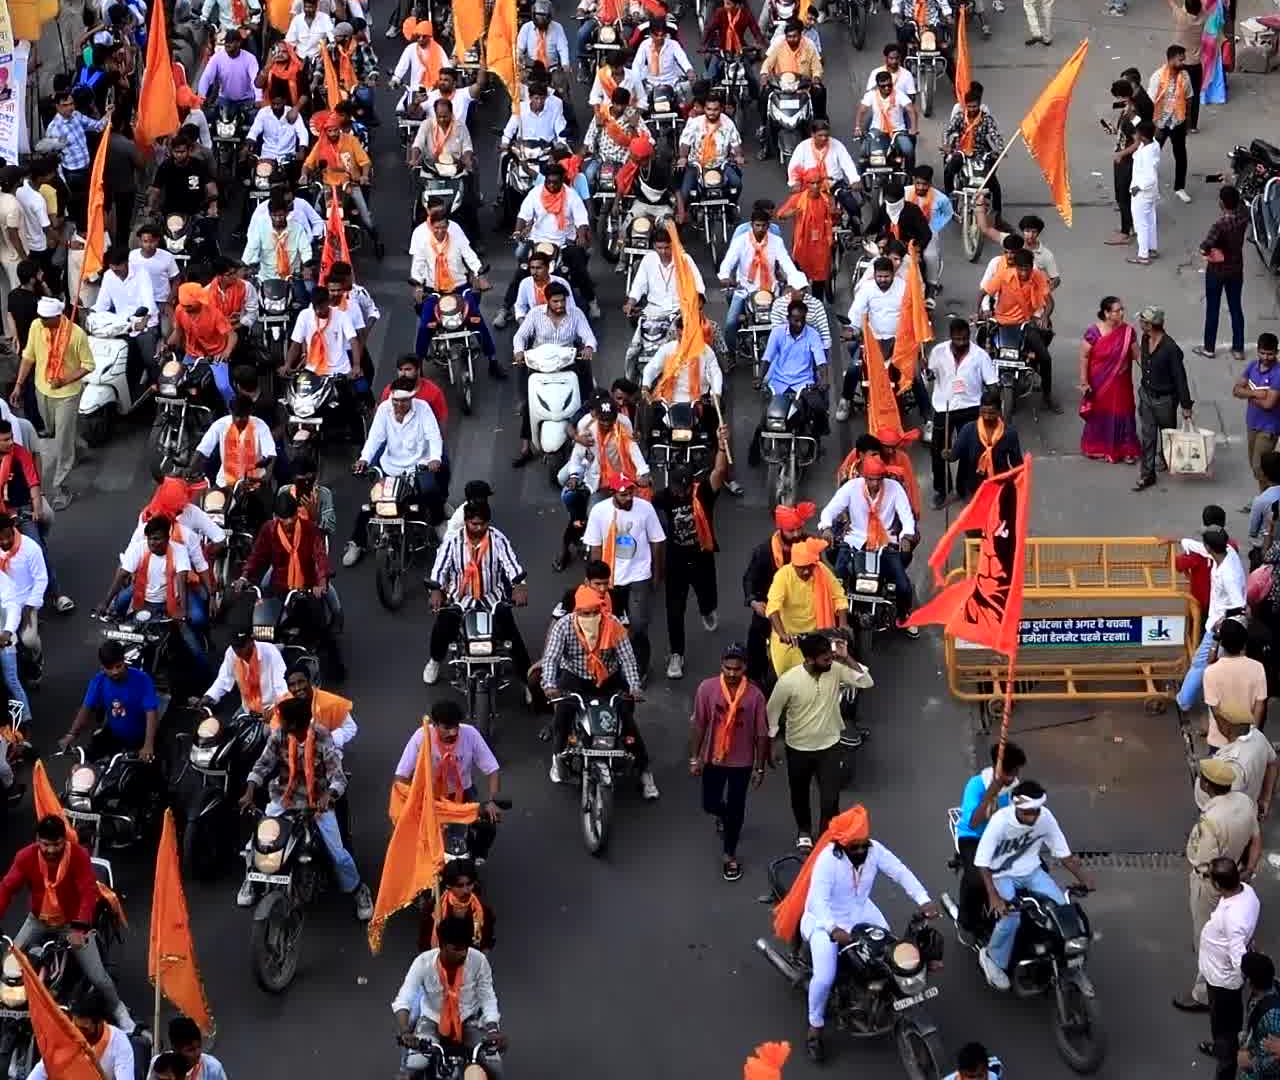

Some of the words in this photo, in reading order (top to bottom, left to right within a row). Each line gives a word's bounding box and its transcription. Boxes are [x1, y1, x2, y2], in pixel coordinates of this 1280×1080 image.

[1032, 618, 1062, 632] दुर्घटना
[1064, 618, 1073, 630] से
[1075, 619, 1096, 630] अगर
[1098, 617, 1105, 629] है
[1106, 619, 1133, 630] बचना,
[1022, 631, 1048, 643] हमेशा
[1050, 631, 1078, 643] हेलमेट
[1080, 631, 1101, 642] पहने
